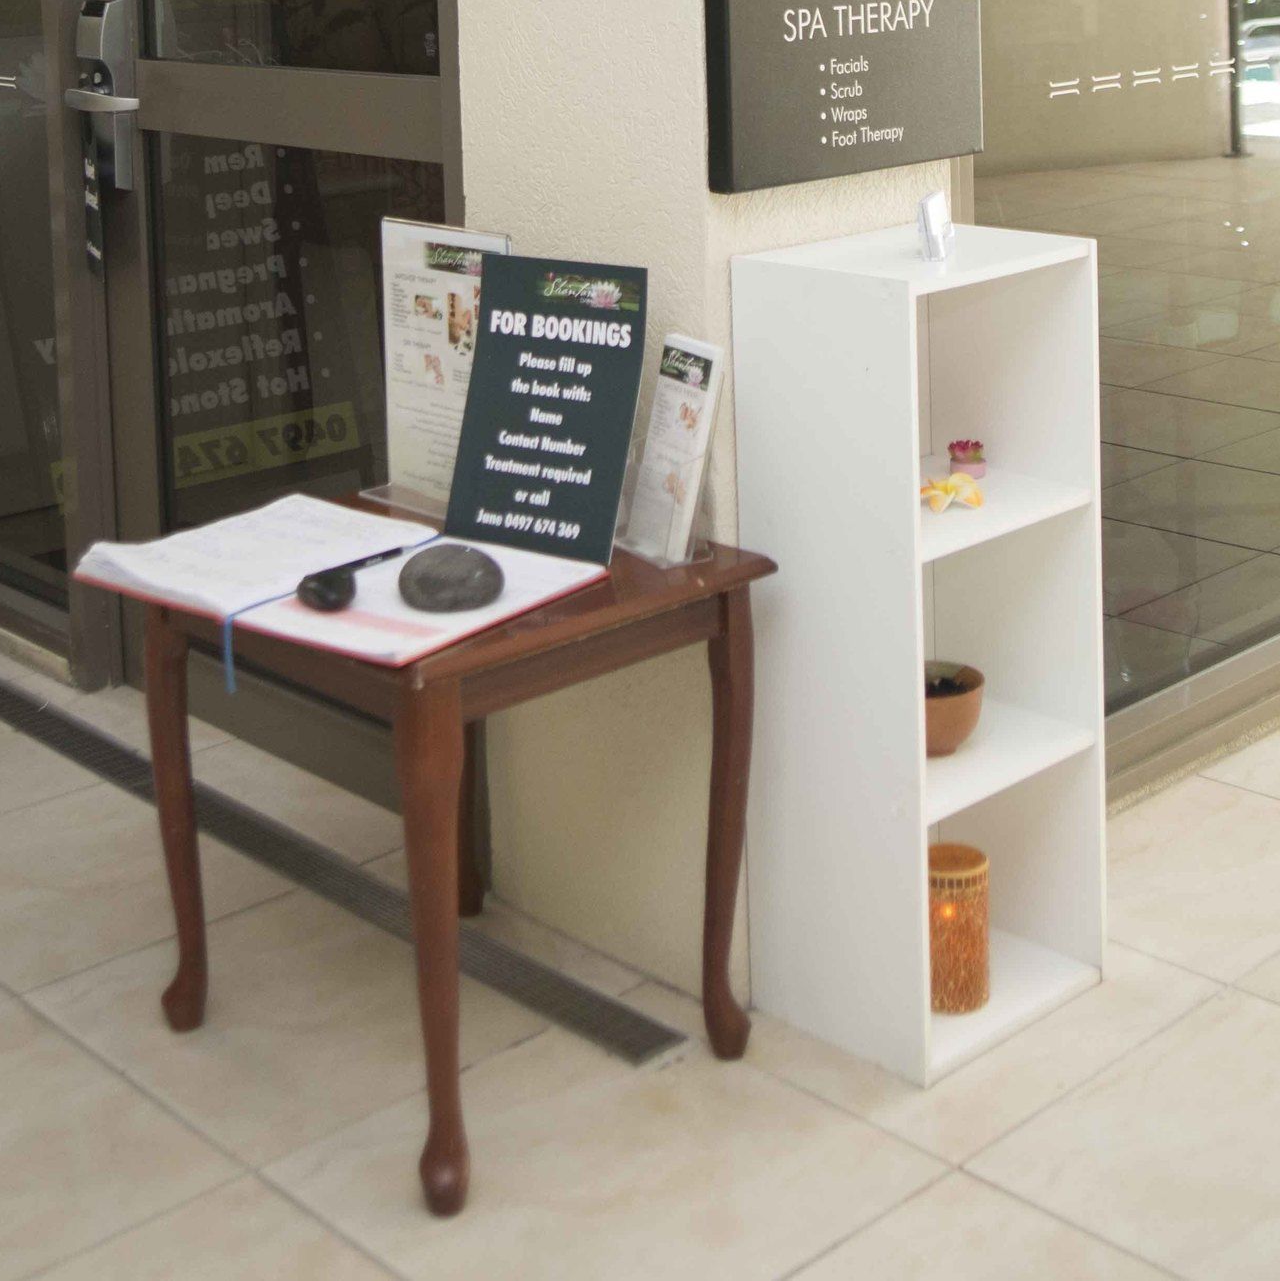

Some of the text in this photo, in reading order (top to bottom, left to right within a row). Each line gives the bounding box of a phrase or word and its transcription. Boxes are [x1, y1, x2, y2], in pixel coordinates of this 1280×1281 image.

[783, 7, 828, 43] SPA
[830, 55, 869, 75] Facials
[830, 80, 863, 100] Scrub
[830, 106, 868, 125] Wraps
[831, 126, 905, 148] Foot Therapy
[490, 309, 632, 348] FOR BOOKINGS
[519, 351, 592, 378] Please fill up
[511, 377, 592, 402] the book with:
[530, 407, 563, 426] Name
[499, 430, 587, 457] Contact Number
[485, 454, 592, 486] Treatment required
[514, 490, 551, 507] or call
[476, 508, 581, 540] Jane 0497 674 369
